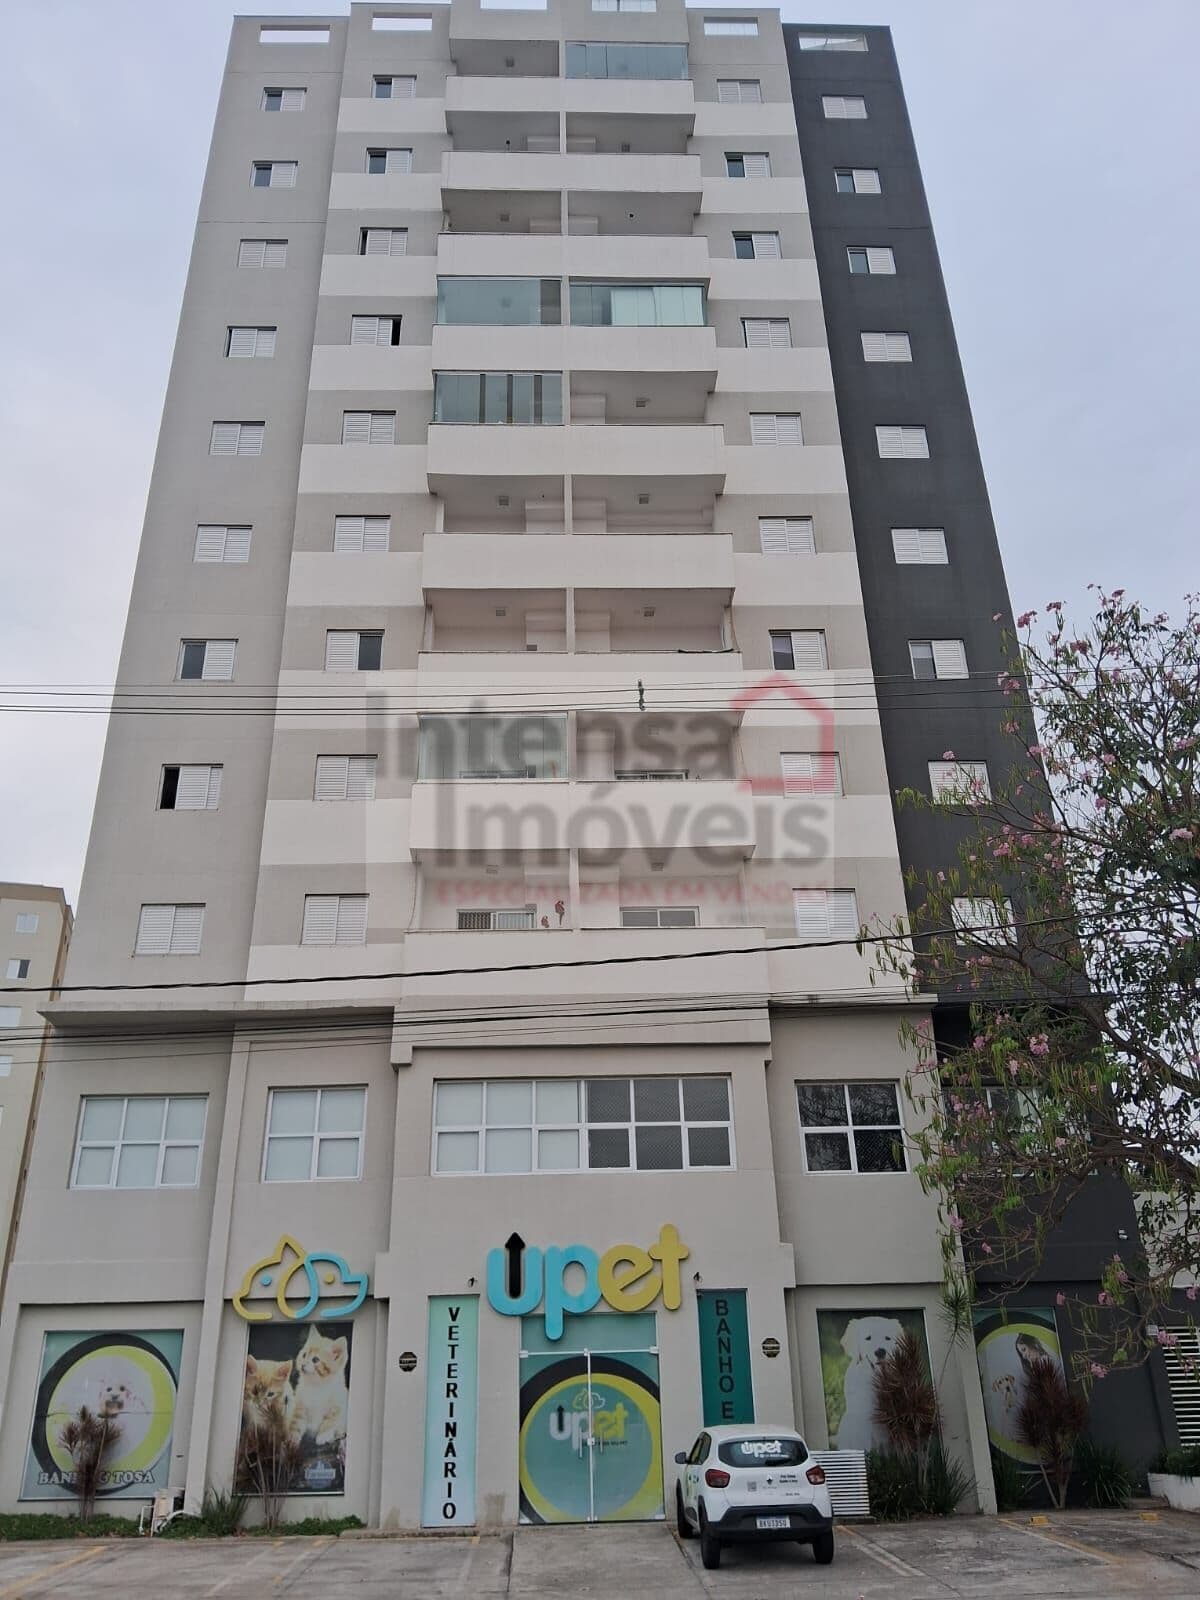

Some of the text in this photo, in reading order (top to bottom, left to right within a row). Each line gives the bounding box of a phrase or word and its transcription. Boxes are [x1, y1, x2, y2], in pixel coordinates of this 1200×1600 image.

[442, 1306, 460, 1520] VETERINÁRIO
[715, 1299, 735, 1419] BANHO E
[113, 1470, 155, 1484] TOSA
